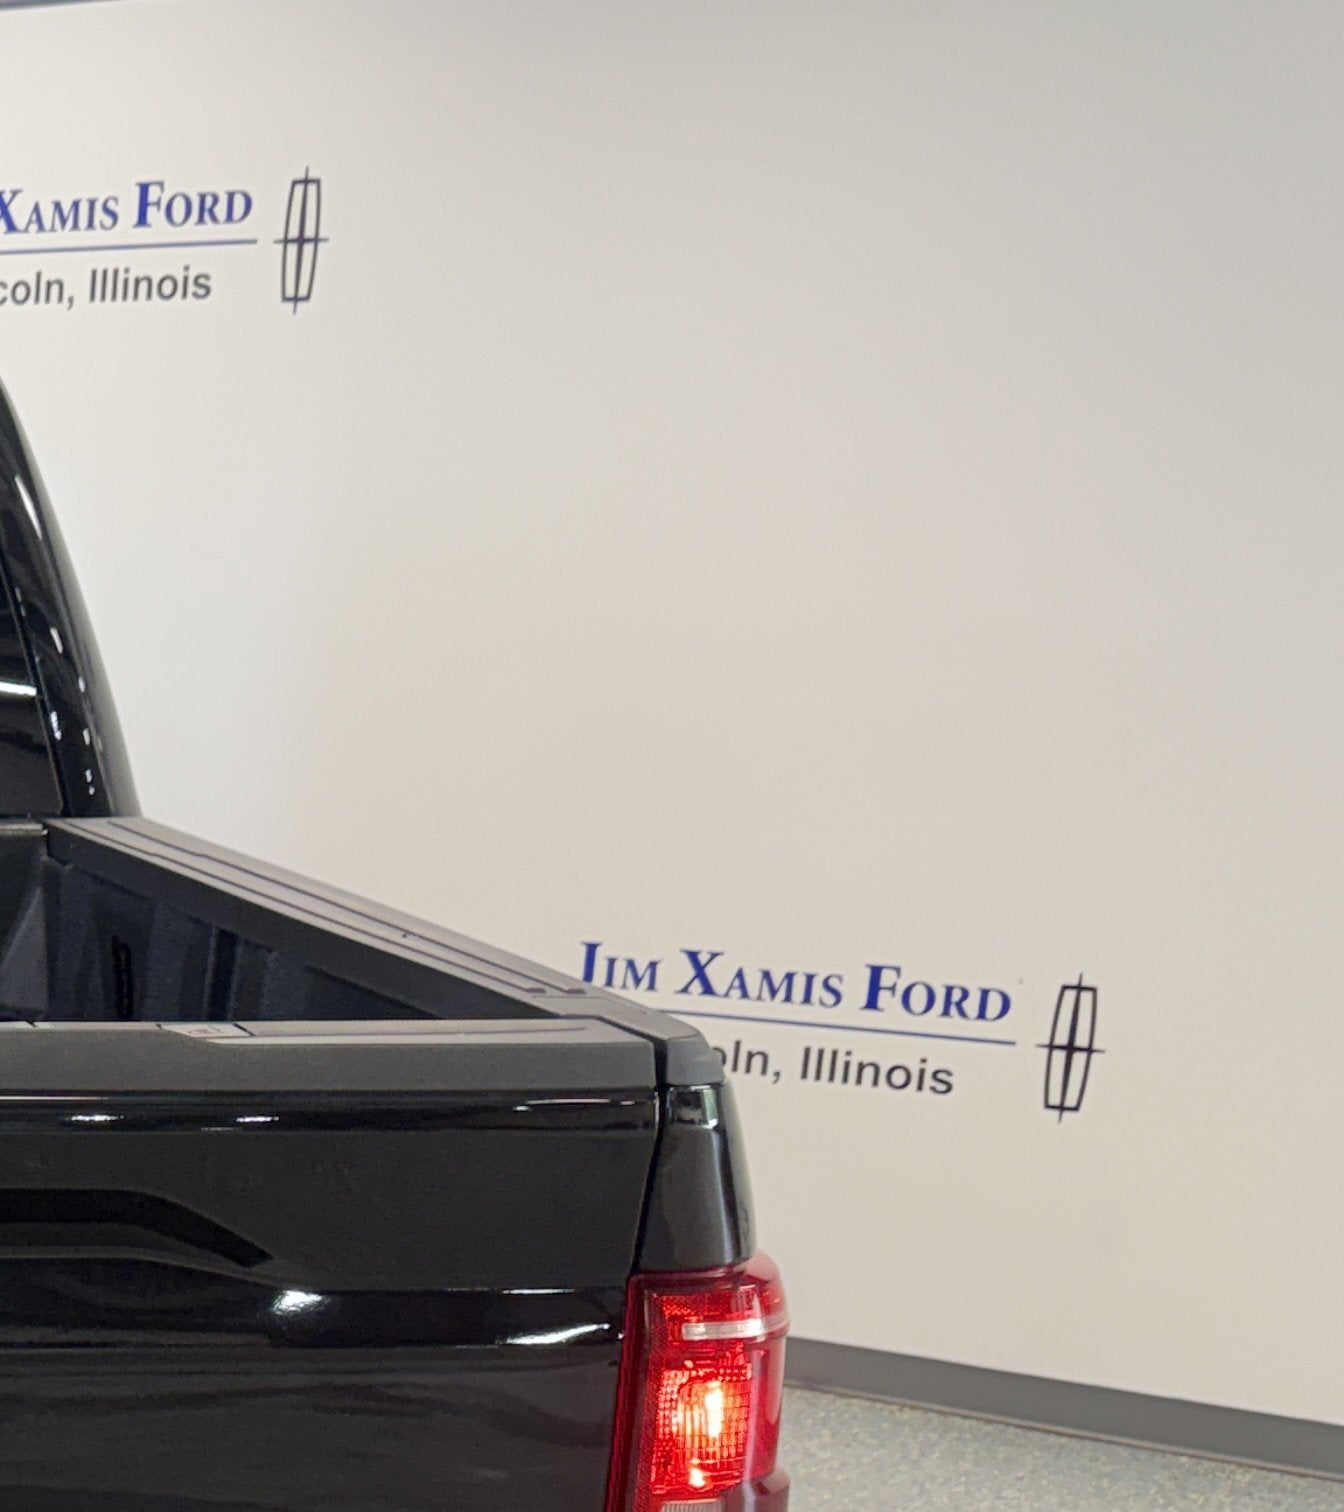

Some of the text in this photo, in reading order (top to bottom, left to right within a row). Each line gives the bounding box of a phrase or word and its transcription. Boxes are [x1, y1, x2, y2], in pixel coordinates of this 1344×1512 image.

[132, 181, 252, 227] FORD
[88, 264, 213, 304] Illinois
[579, 942, 1012, 1022] JIM XAMIS FORD
[800, 1047, 954, 1095] Illinois
